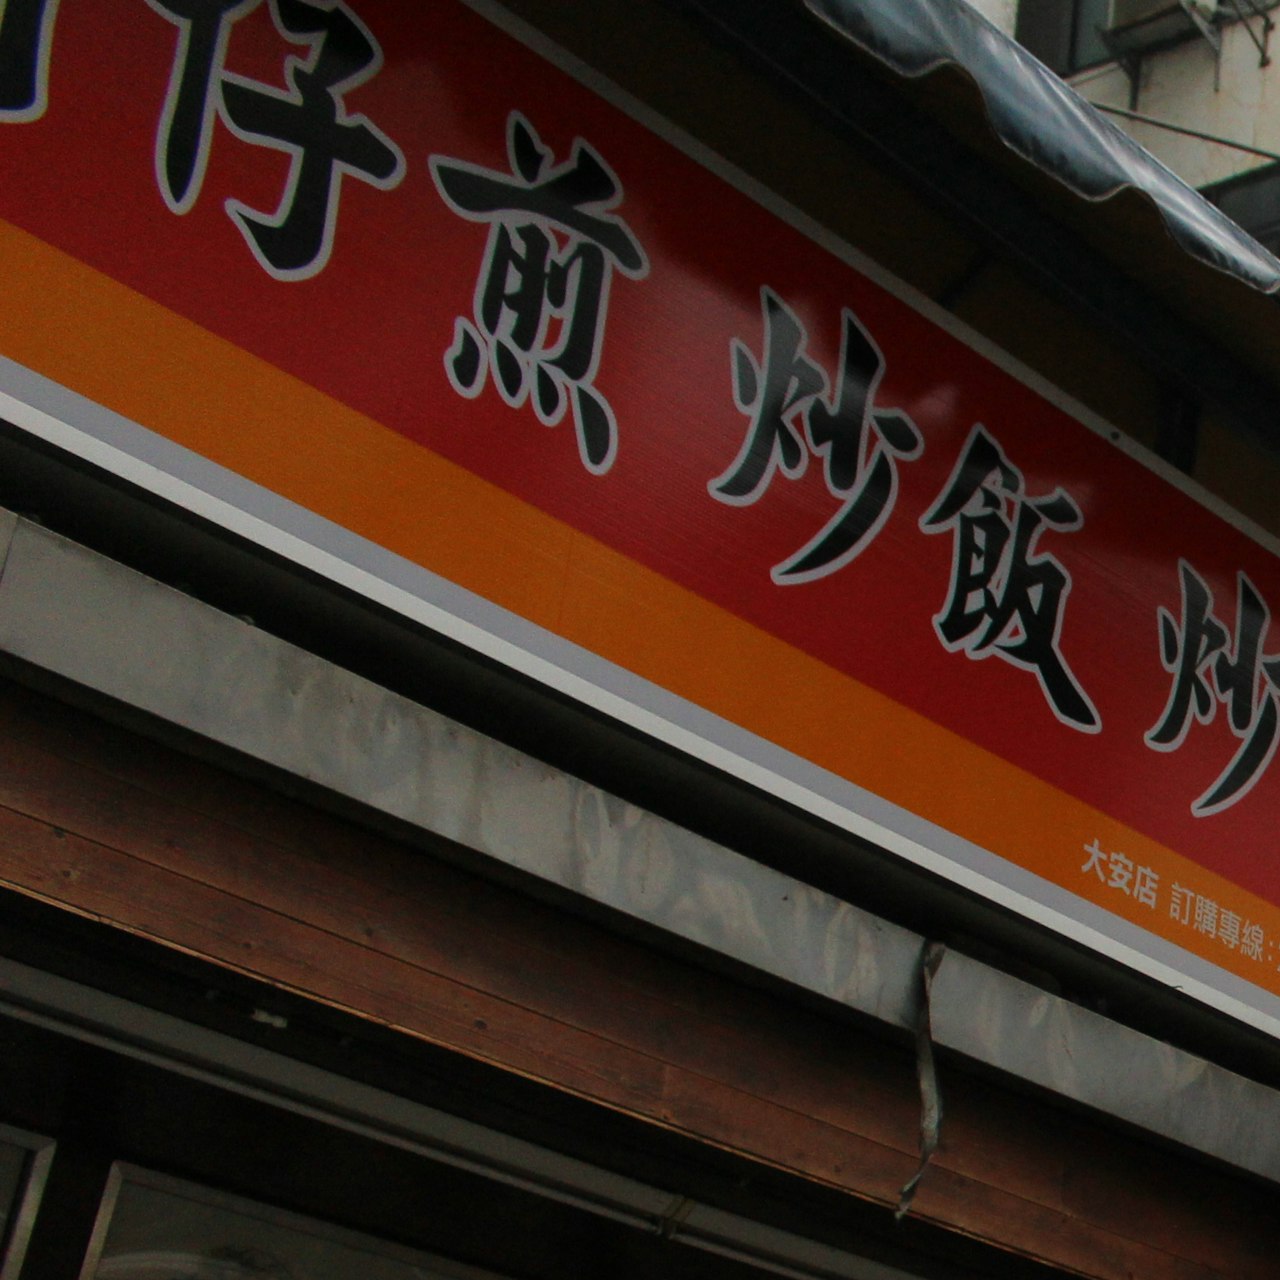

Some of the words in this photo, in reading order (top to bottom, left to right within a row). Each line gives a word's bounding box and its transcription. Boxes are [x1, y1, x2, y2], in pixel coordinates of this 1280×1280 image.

[0, 0, 650, 474] 仔煎
[1080, 837, 1160, 910] 大安店
